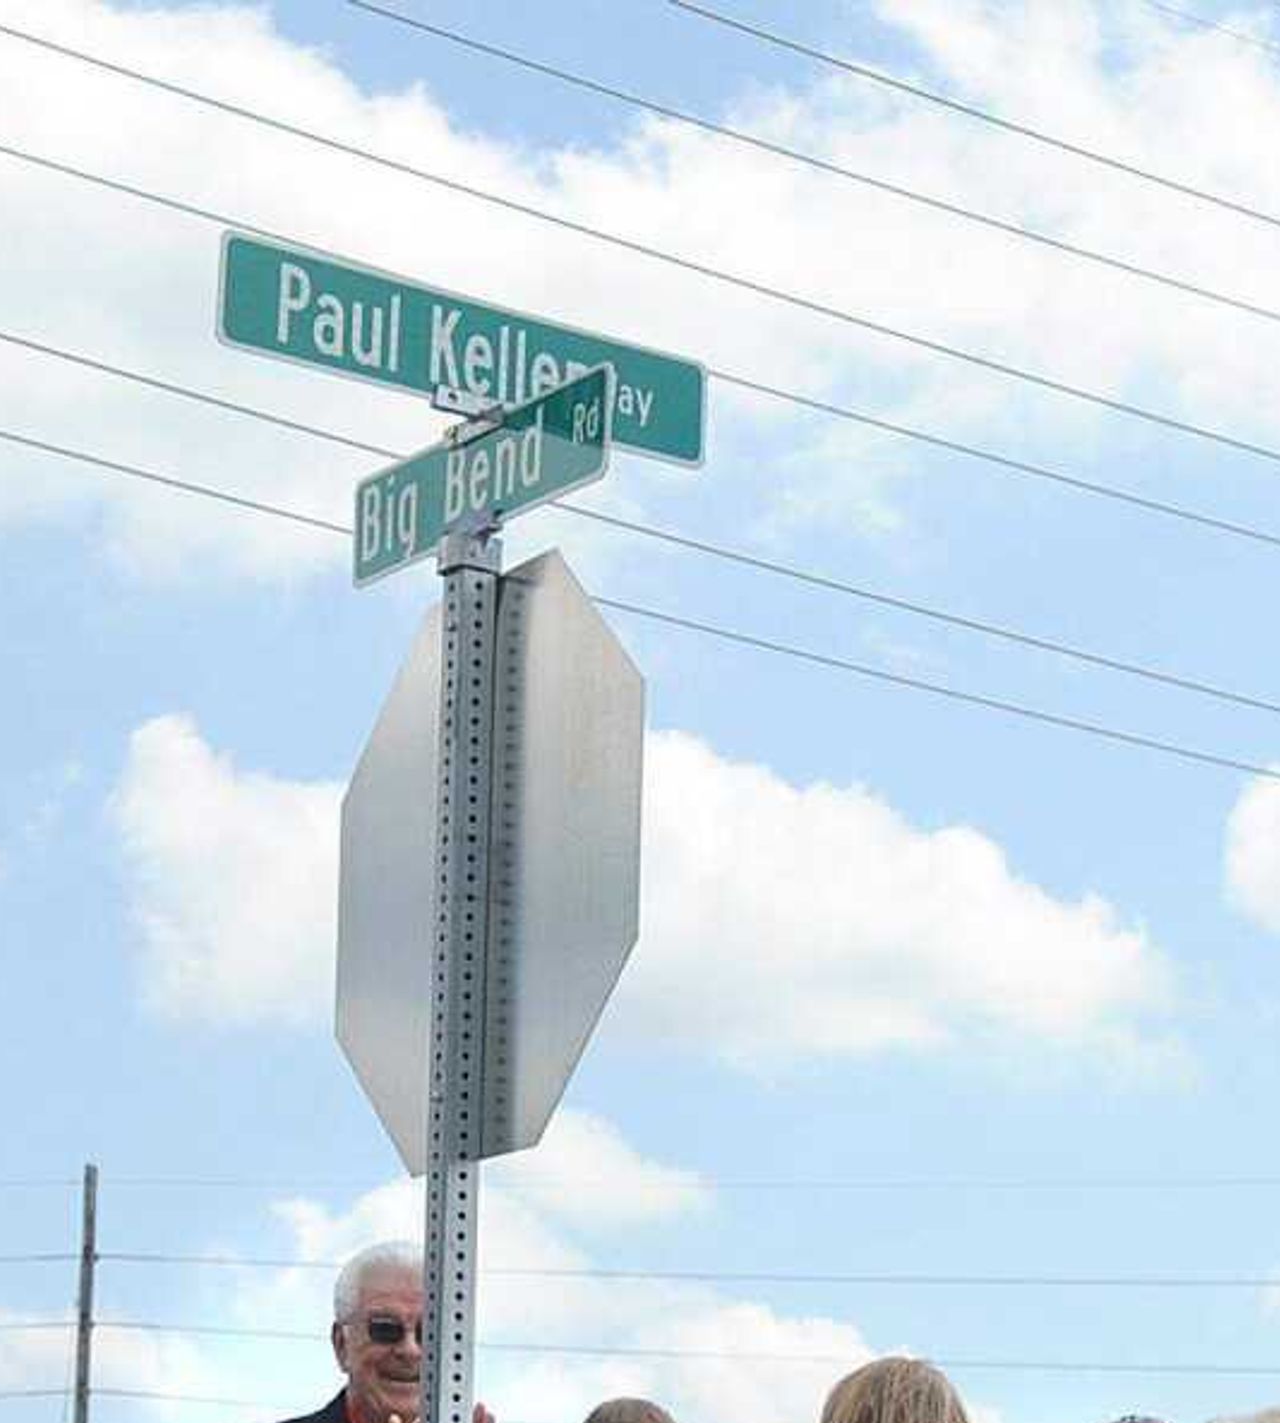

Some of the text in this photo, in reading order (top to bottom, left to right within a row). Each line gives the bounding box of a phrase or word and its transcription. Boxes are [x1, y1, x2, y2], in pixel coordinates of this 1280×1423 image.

[276, 261, 402, 373] Paul
[617, 383, 654, 428] ay
[360, 397, 599, 561] Big Bend Rd
